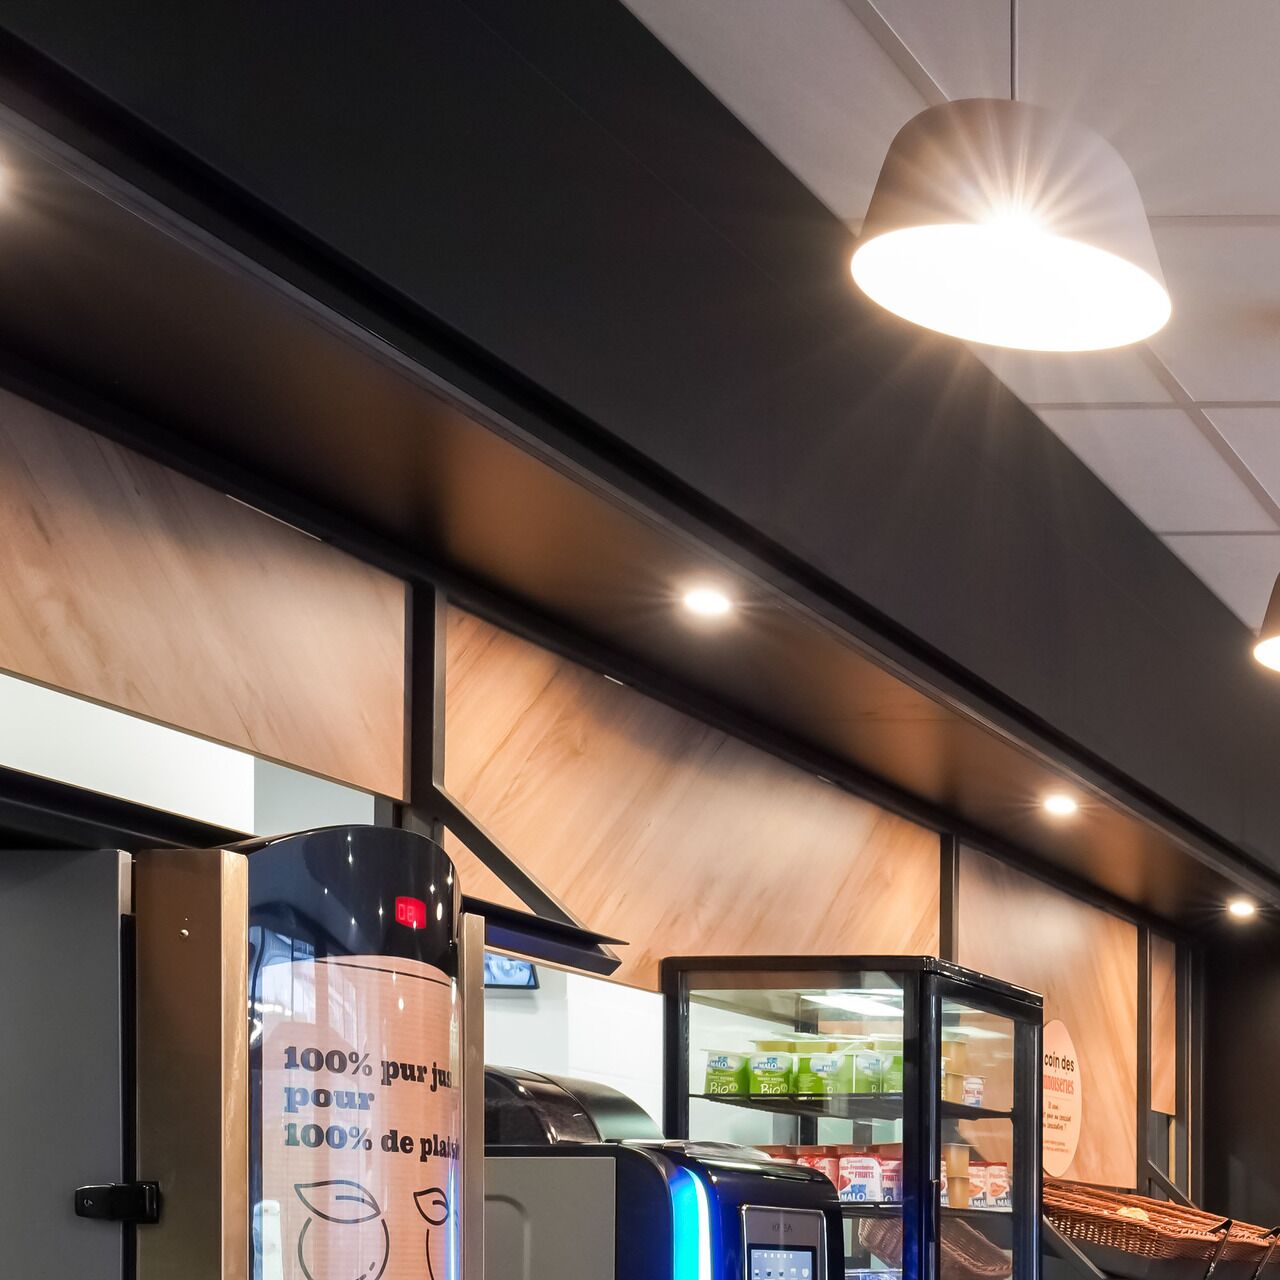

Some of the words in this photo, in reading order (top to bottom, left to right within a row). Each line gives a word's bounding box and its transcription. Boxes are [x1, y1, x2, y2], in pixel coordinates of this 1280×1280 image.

[284, 1046, 373, 1076] 100%
[381, 1060, 428, 1086] pur
[430, 1062, 453, 1093] jus
[1044, 1052, 1060, 1070] coin
[1061, 1055, 1075, 1072] des
[710, 1081, 729, 1094] Bio
[760, 1083, 781, 1094] Bio
[284, 1086, 375, 1113] pour
[284, 1122, 373, 1151] 100%
[381, 1129, 415, 1154] de
